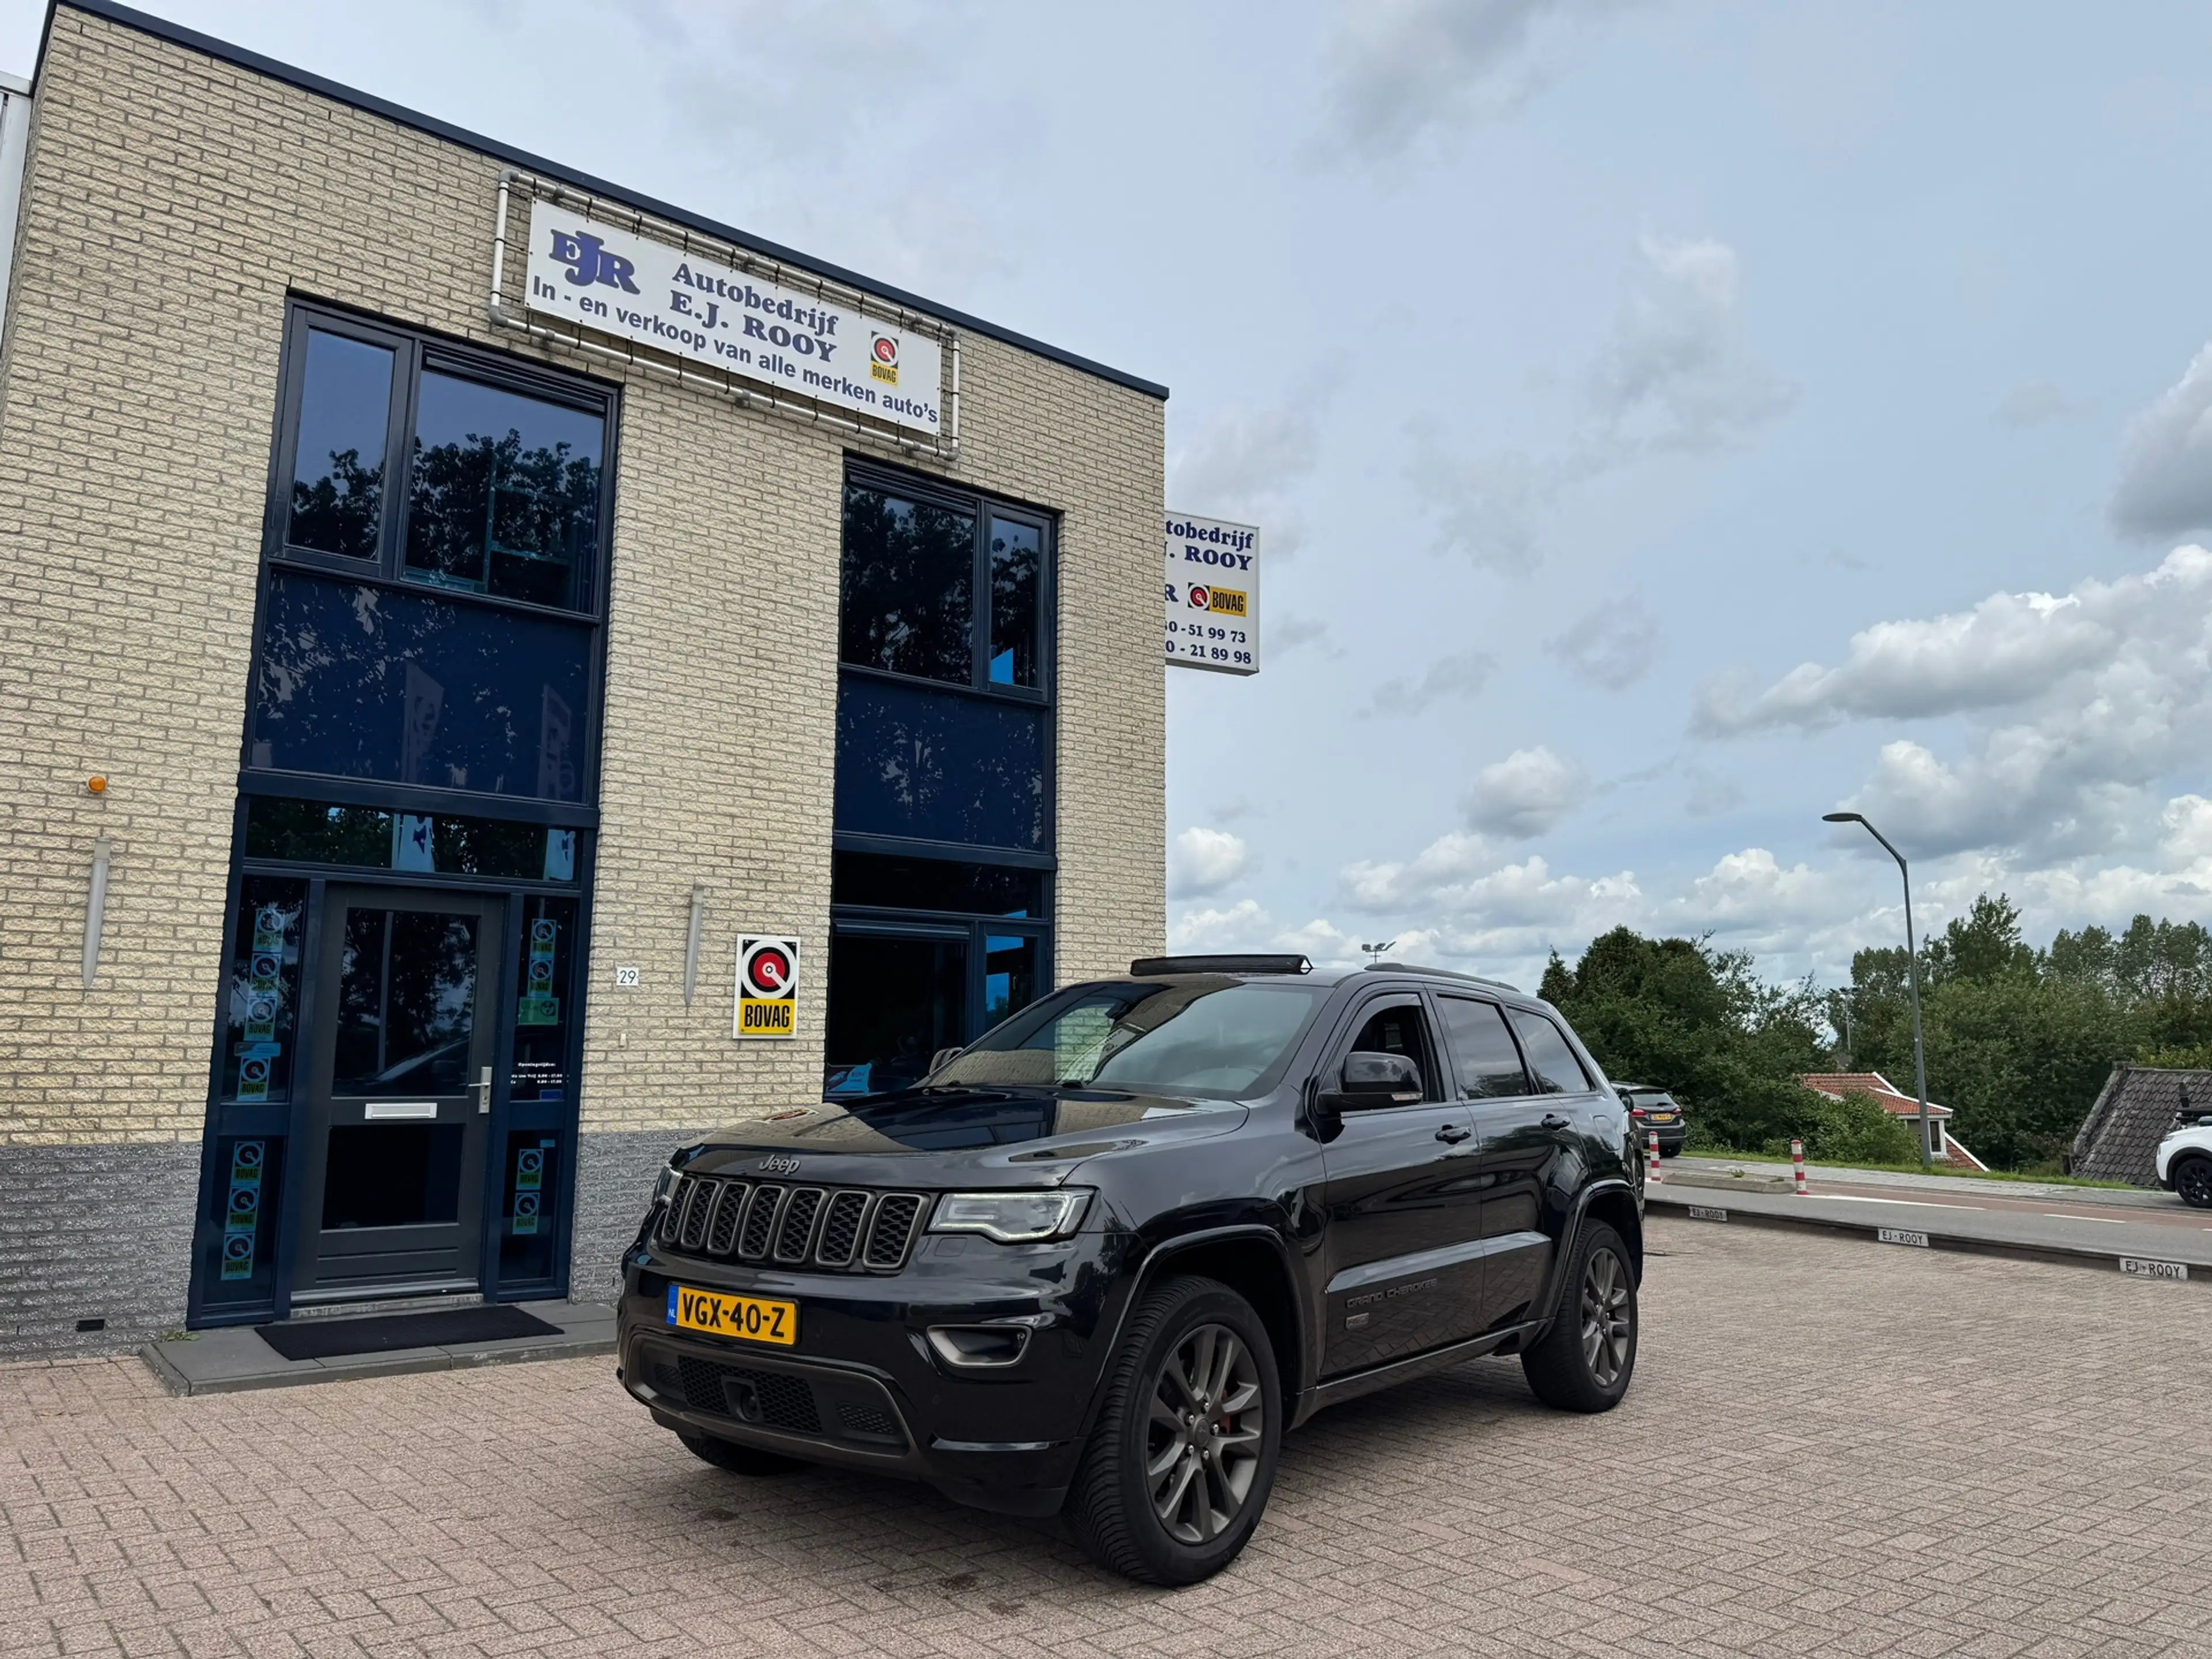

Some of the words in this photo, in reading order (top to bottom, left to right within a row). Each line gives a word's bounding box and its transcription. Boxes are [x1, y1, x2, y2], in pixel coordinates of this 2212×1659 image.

[549, 229, 641, 295] EJR
[672, 263, 839, 336] Autobedrijf
[670, 290, 729, 329] E.J.
[743, 314, 837, 362] ROOY
[533, 275, 555, 300] In
[579, 296, 607, 317] en
[616, 307, 706, 351] verkoop
[714, 339, 751, 363] van
[759, 354, 796, 377] alle
[803, 368, 876, 404] merken
[882, 395, 938, 423] auto's
[872, 364, 896, 383] BOVAG
[1184, 545, 1253, 571] ROOY
[1213, 590, 1244, 612] BOVAG
[1188, 624, 1204, 637] 51
[1208, 627, 1225, 640] 99
[1230, 630, 1246, 643] 73
[1190, 644, 1206, 658] 21
[1211, 647, 1228, 661] 89
[1234, 651, 1251, 664] 98
[619, 969, 637, 984] 29
[744, 1005, 790, 1028] BOVAG
[242, 1084, 265, 1093] BOVAG
[236, 1168, 257, 1179] BOVAG
[758, 1154, 801, 1176] Jeep
[226, 1260, 248, 1272] BOVAG
[1345, 1291, 1383, 1308] GRAND
[1385, 1278, 1437, 1298] CHEROKEE
[668, 1308, 676, 1318] NL
[683, 1293, 786, 1338] VGX-40-Z
